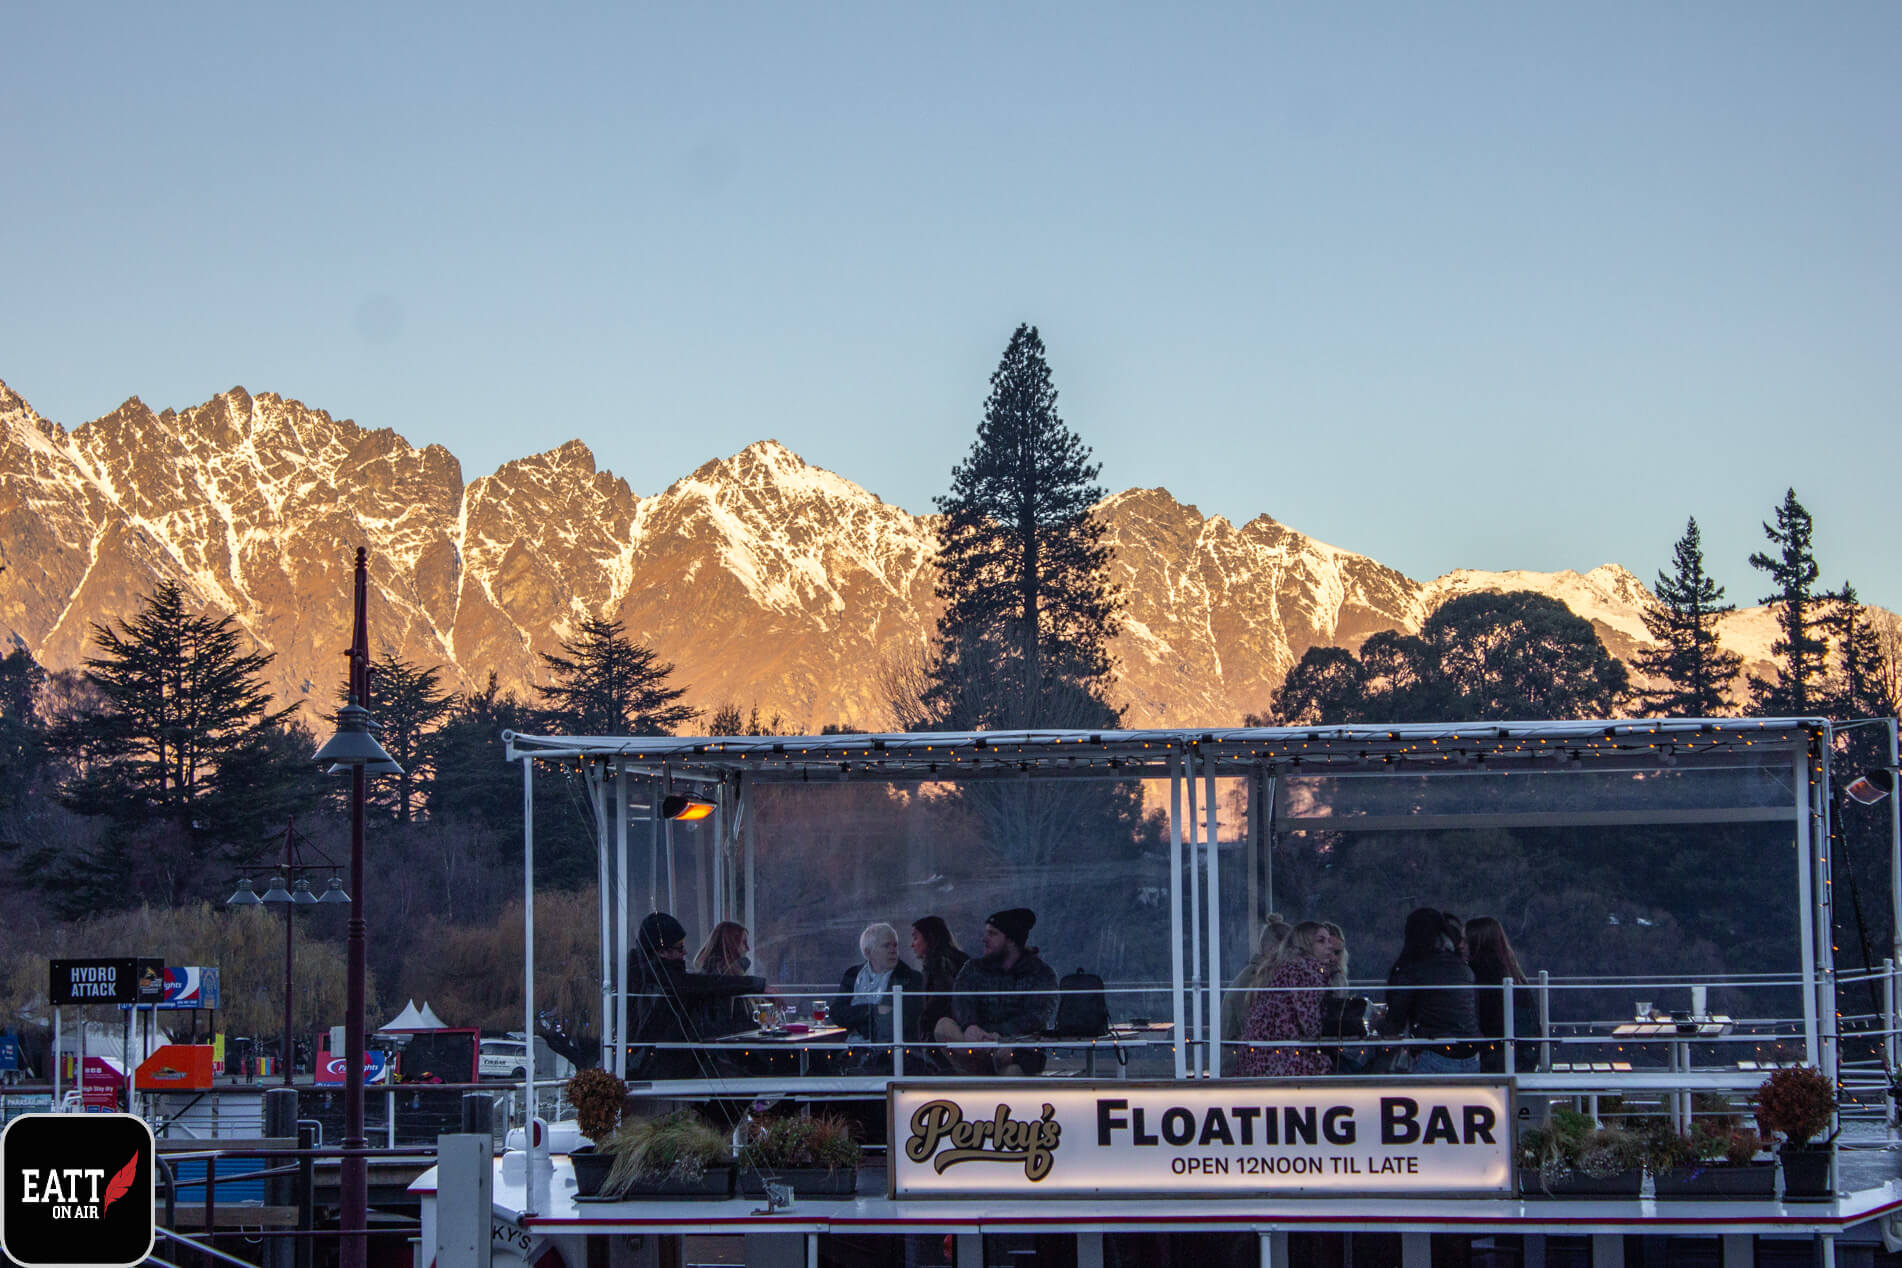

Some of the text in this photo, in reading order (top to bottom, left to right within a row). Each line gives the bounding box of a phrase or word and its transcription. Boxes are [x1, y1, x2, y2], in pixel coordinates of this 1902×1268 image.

[71, 967, 116, 983] HYDRO
[71, 982, 117, 998] ATTACK
[163, 981, 183, 991] ights
[905, 1099, 1062, 1182] Perky's
[1171, 1156, 1420, 1175] OPEN 12NOON TIL LATE
[492, 1225, 532, 1250] KY'S
